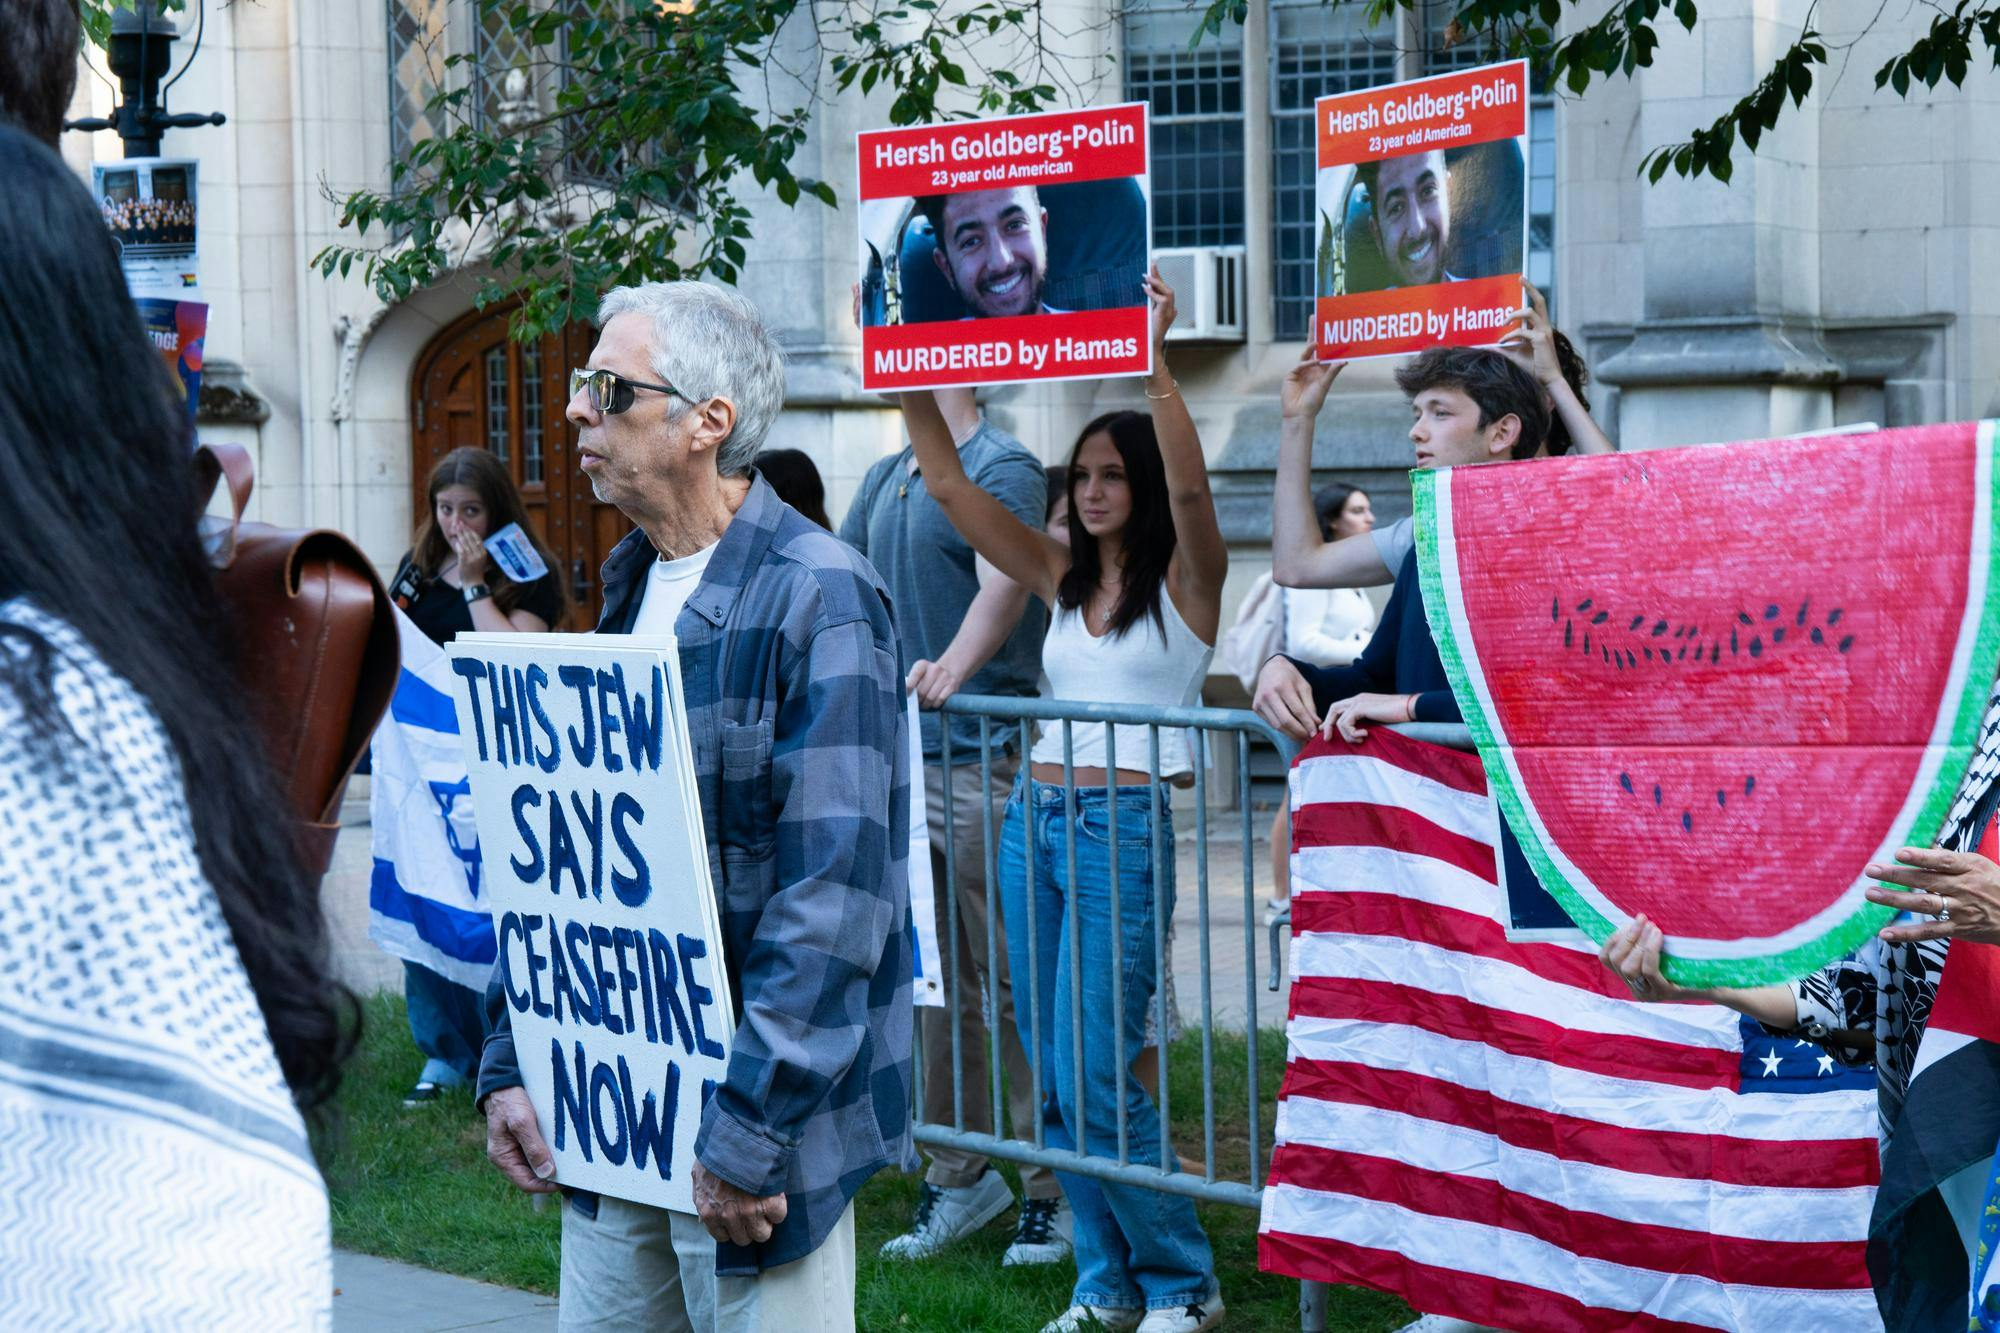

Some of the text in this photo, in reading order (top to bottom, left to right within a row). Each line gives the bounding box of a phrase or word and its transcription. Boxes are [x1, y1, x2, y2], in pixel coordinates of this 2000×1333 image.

[1329, 78, 1517, 135] Hersh Goldberg-Polin
[875, 119, 1135, 168] Hersh Goldberg-Polin
[1369, 123, 1472, 154] 23 year old American
[931, 159, 1073, 188] 23 year old American
[148, 331, 178, 350] DGE
[1324, 311, 1422, 345] MURDERED
[1427, 309, 1449, 340] by
[874, 337, 1138, 374] MURDERED by Hamas
[451, 657, 664, 776] THIS JEW
[510, 783, 652, 907] SAYS
[500, 910, 726, 1060] CEASEFIRE
